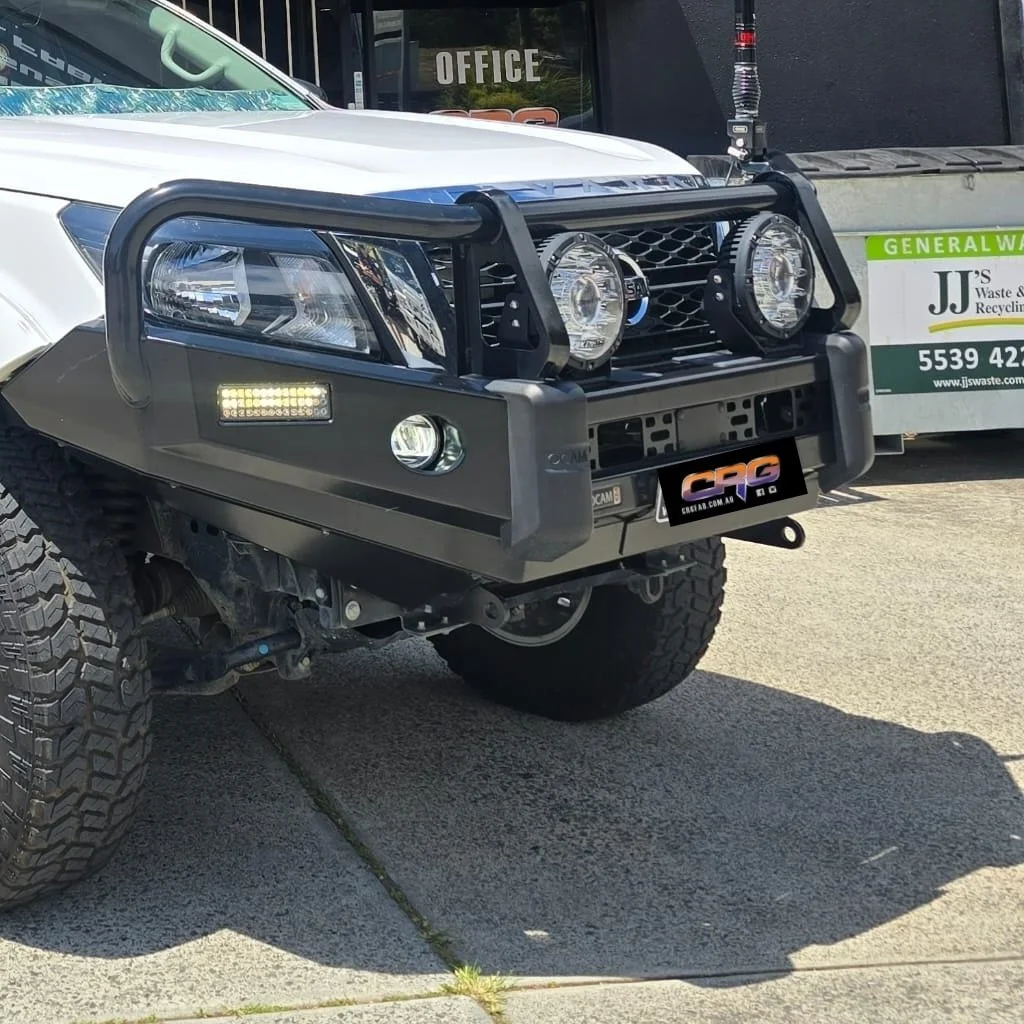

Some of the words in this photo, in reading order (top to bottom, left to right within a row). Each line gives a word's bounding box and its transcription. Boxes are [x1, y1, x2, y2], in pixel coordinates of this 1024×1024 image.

[435, 48, 542, 86] OFFICE
[883, 235, 992, 256] GENERAL
[975, 286, 1012, 299] Waste
[918, 347, 979, 371] 5539
[989, 346, 1024, 369] 42
